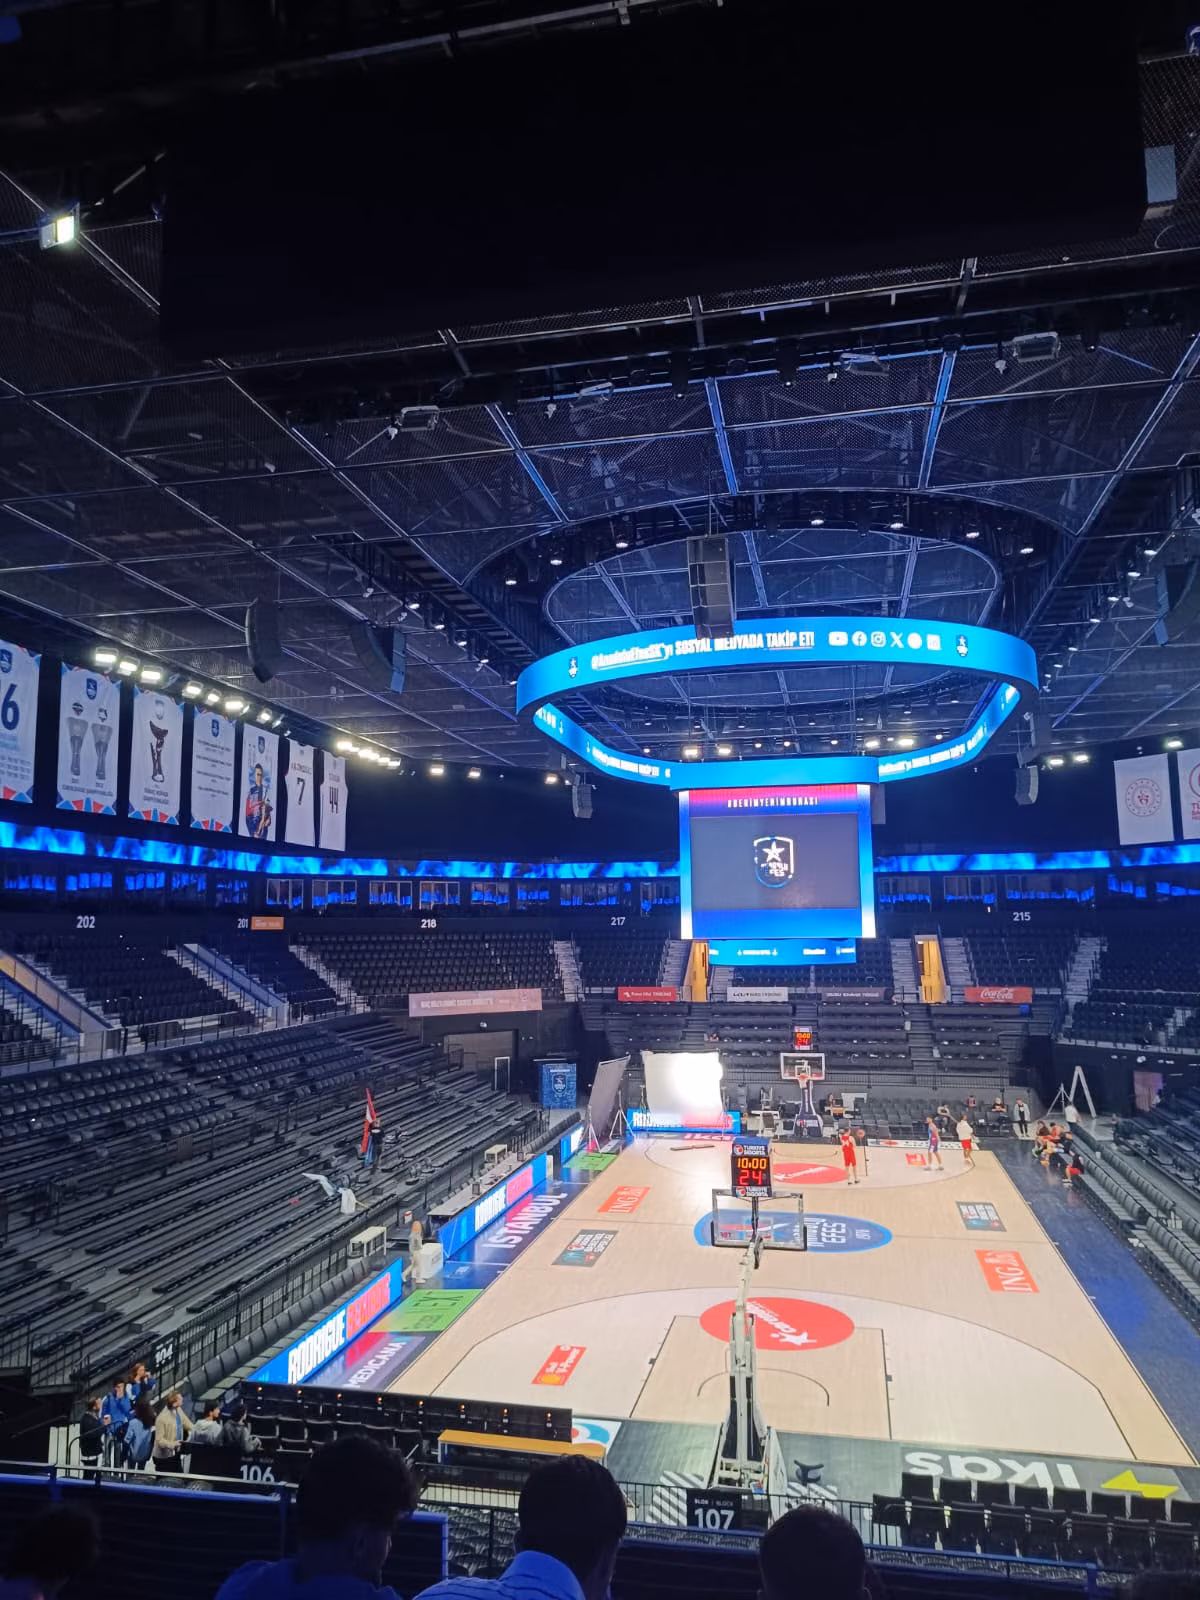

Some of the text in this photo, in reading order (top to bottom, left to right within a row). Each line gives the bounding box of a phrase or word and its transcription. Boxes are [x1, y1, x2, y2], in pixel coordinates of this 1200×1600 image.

[297, 777, 306, 806] 7
[76, 916, 96, 928] 202
[237, 918, 249, 929] 201
[420, 918, 437, 929] 218
[610, 916, 626, 926] 217
[1012, 911, 1031, 921] 215
[739, 1169, 763, 1186] 24
[607, 1196, 640, 1214] ING
[820, 1222, 847, 1245] EFES
[994, 1266, 1034, 1292] ING
[154, 1345, 174, 1368] 104
[288, 1308, 346, 1385] RODRIGUE
[343, 1341, 407, 1388] MEDICANA
[239, 1464, 276, 1484] 106
[694, 1508, 735, 1531] 107
